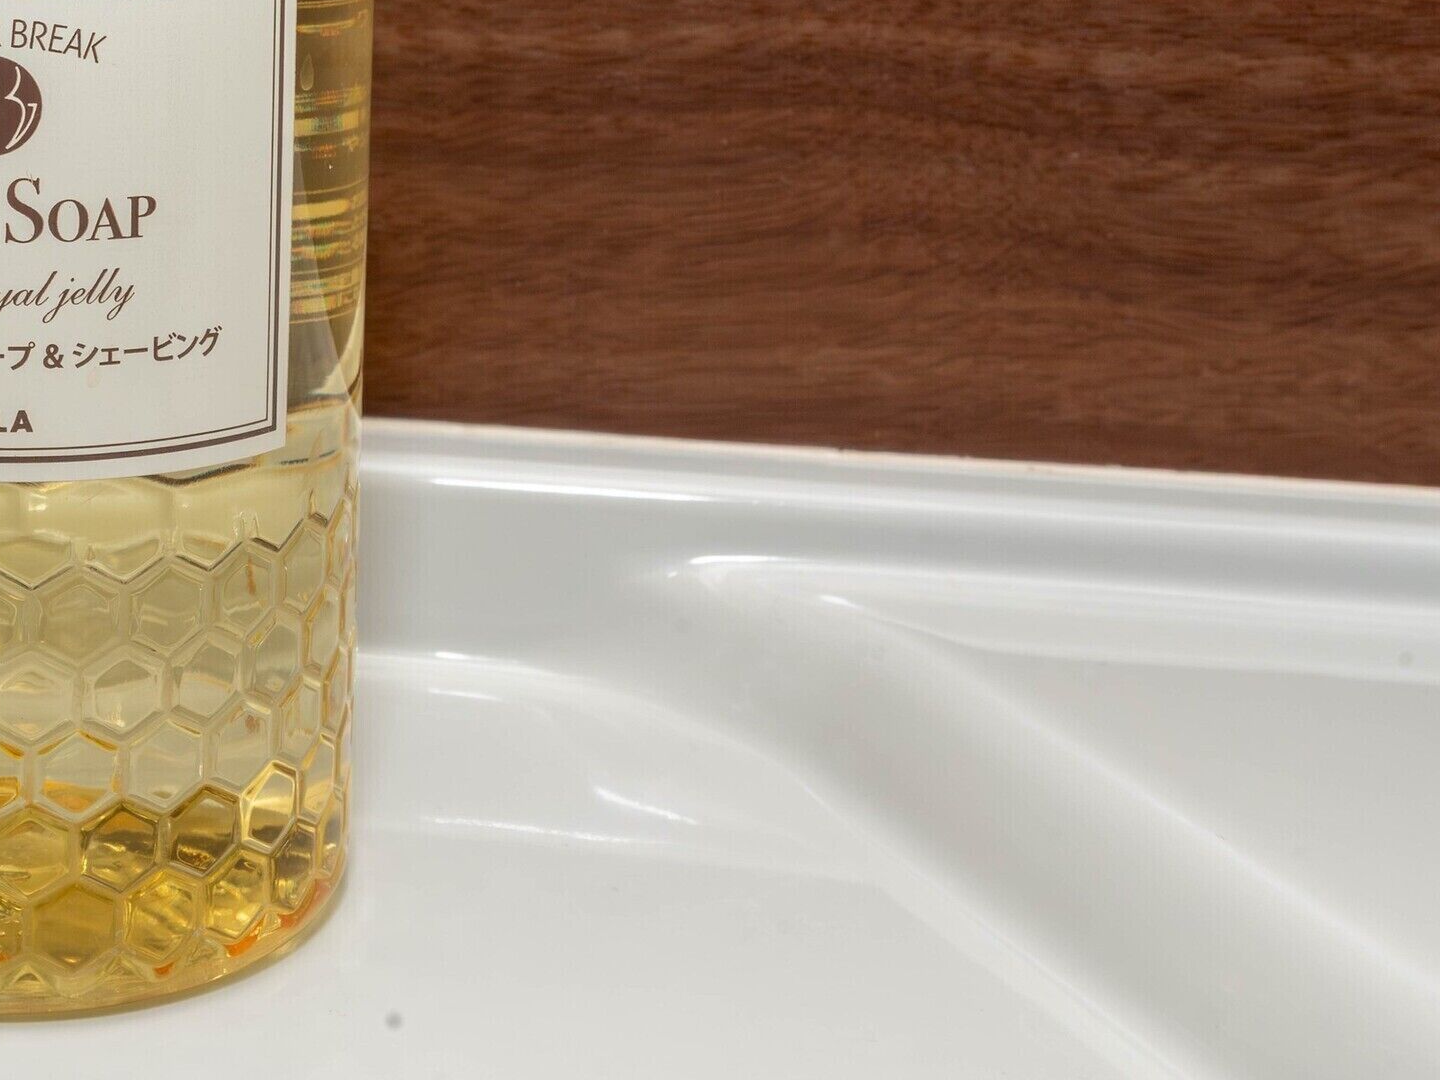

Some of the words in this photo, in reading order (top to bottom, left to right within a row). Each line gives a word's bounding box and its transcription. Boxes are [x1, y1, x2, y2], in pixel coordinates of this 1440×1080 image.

[9, 19, 108, 64] BREAK
[5, 177, 157, 244] SOAP
[41, 267, 136, 324] jelly
[42, 343, 65, 370] &
[72, 325, 223, 369] シェービング
